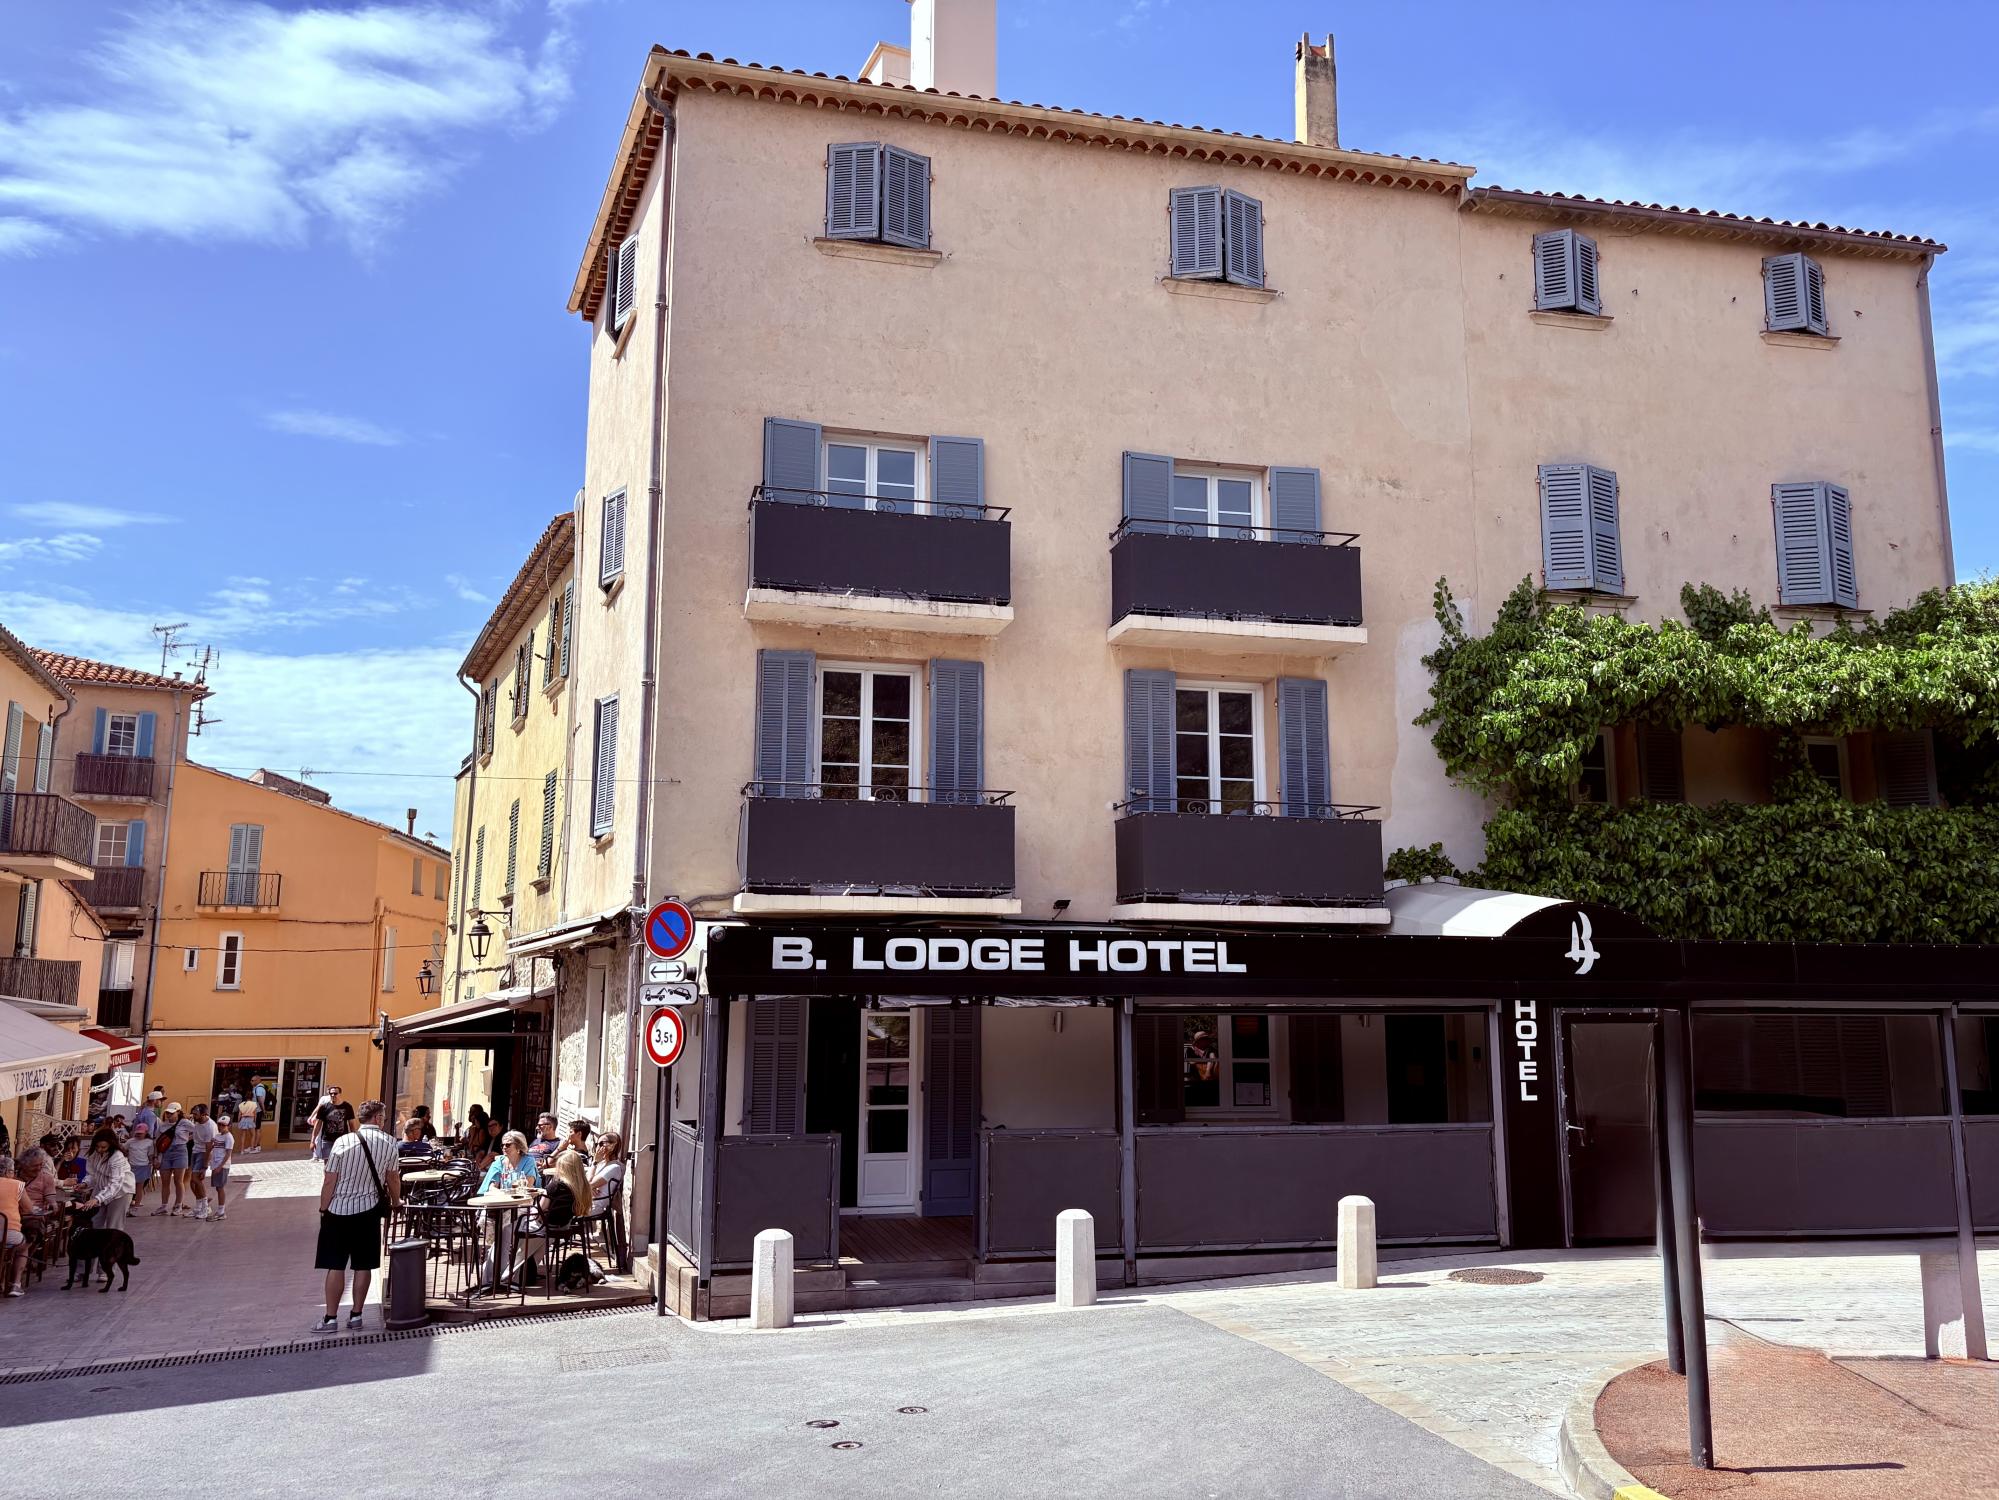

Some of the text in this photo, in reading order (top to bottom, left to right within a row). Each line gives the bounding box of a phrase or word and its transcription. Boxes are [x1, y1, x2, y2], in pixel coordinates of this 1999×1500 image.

[771, 936, 1247, 973] B. LODGE HOTEL
[1514, 999, 1538, 1101] HOTEL
